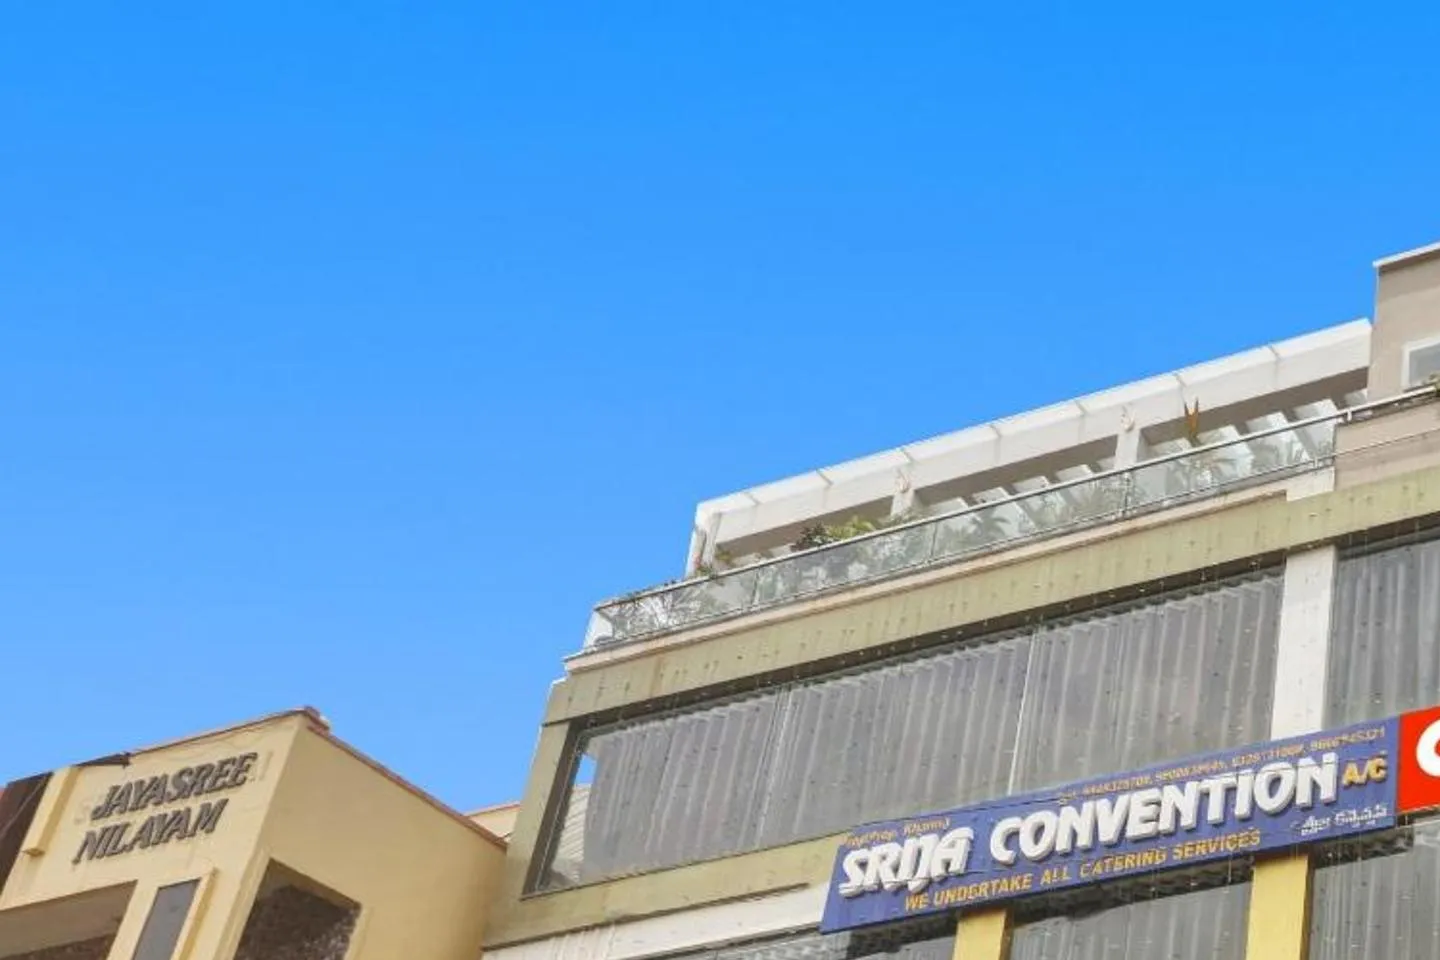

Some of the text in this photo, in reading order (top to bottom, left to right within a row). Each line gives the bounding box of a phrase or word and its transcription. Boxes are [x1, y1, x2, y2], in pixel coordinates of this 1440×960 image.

[90, 752, 258, 821] JAYASREE
[72, 798, 229, 864] NILAYAM
[838, 827, 974, 899] SRIJA
[990, 752, 1339, 865] CONVENTION
[1342, 756, 1389, 787] A/C
[905, 828, 1261, 912] WE UNDERTAKE ALL CATERING SERVICES
